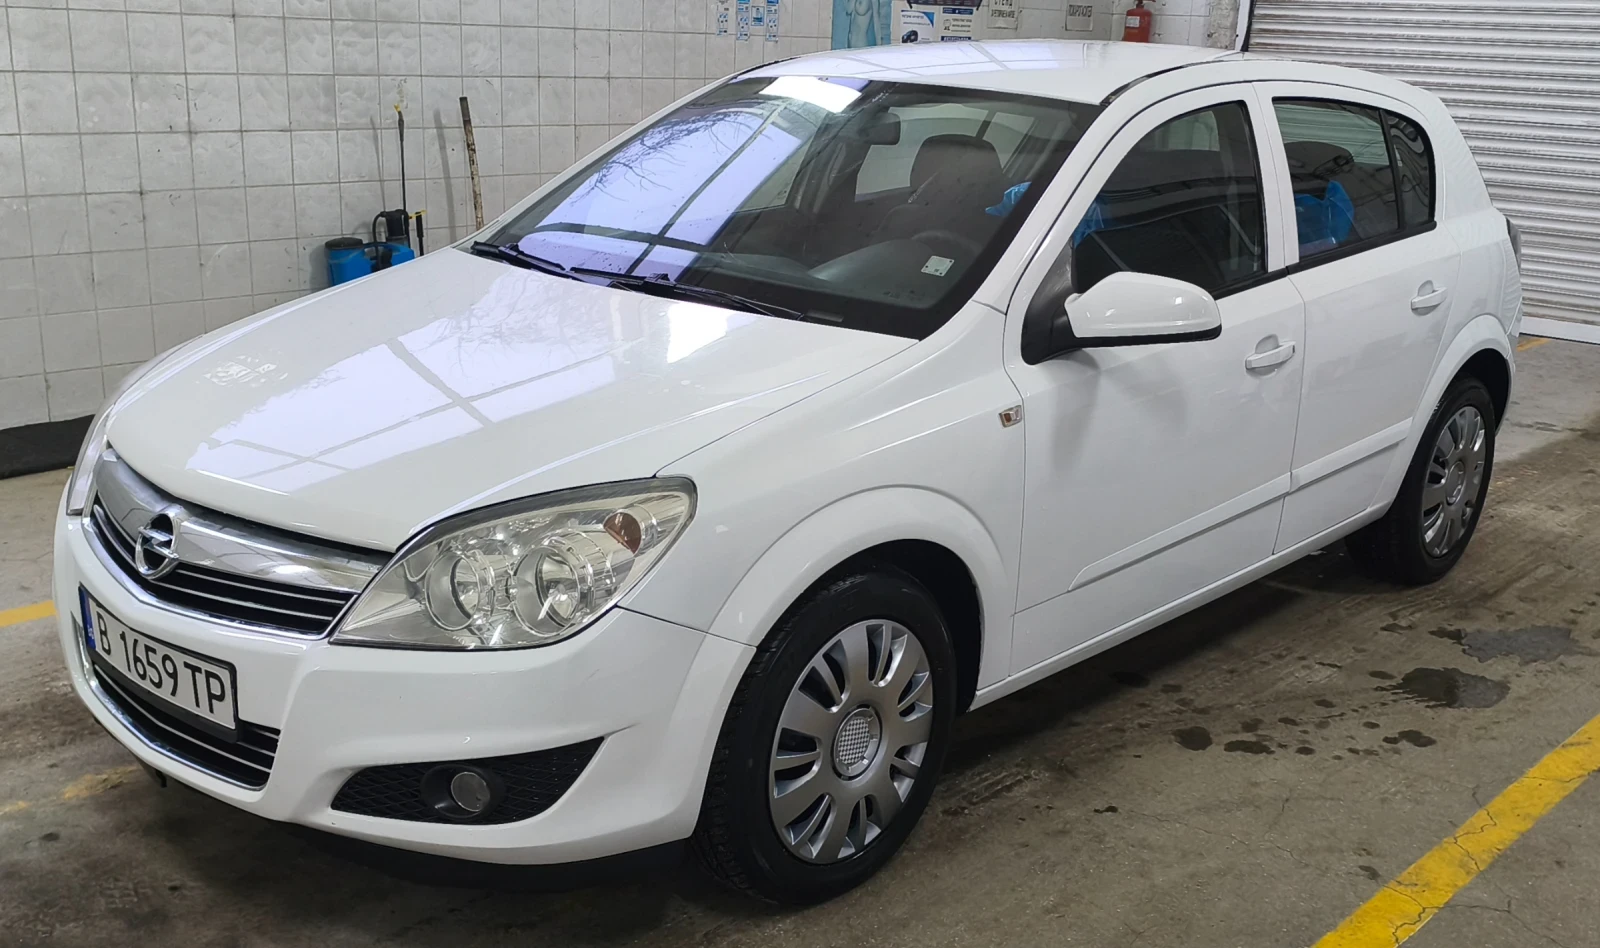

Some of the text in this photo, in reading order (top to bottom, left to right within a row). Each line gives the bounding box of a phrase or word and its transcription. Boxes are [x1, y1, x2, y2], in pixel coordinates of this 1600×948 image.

[96, 611, 225, 714] B 1659 TP
